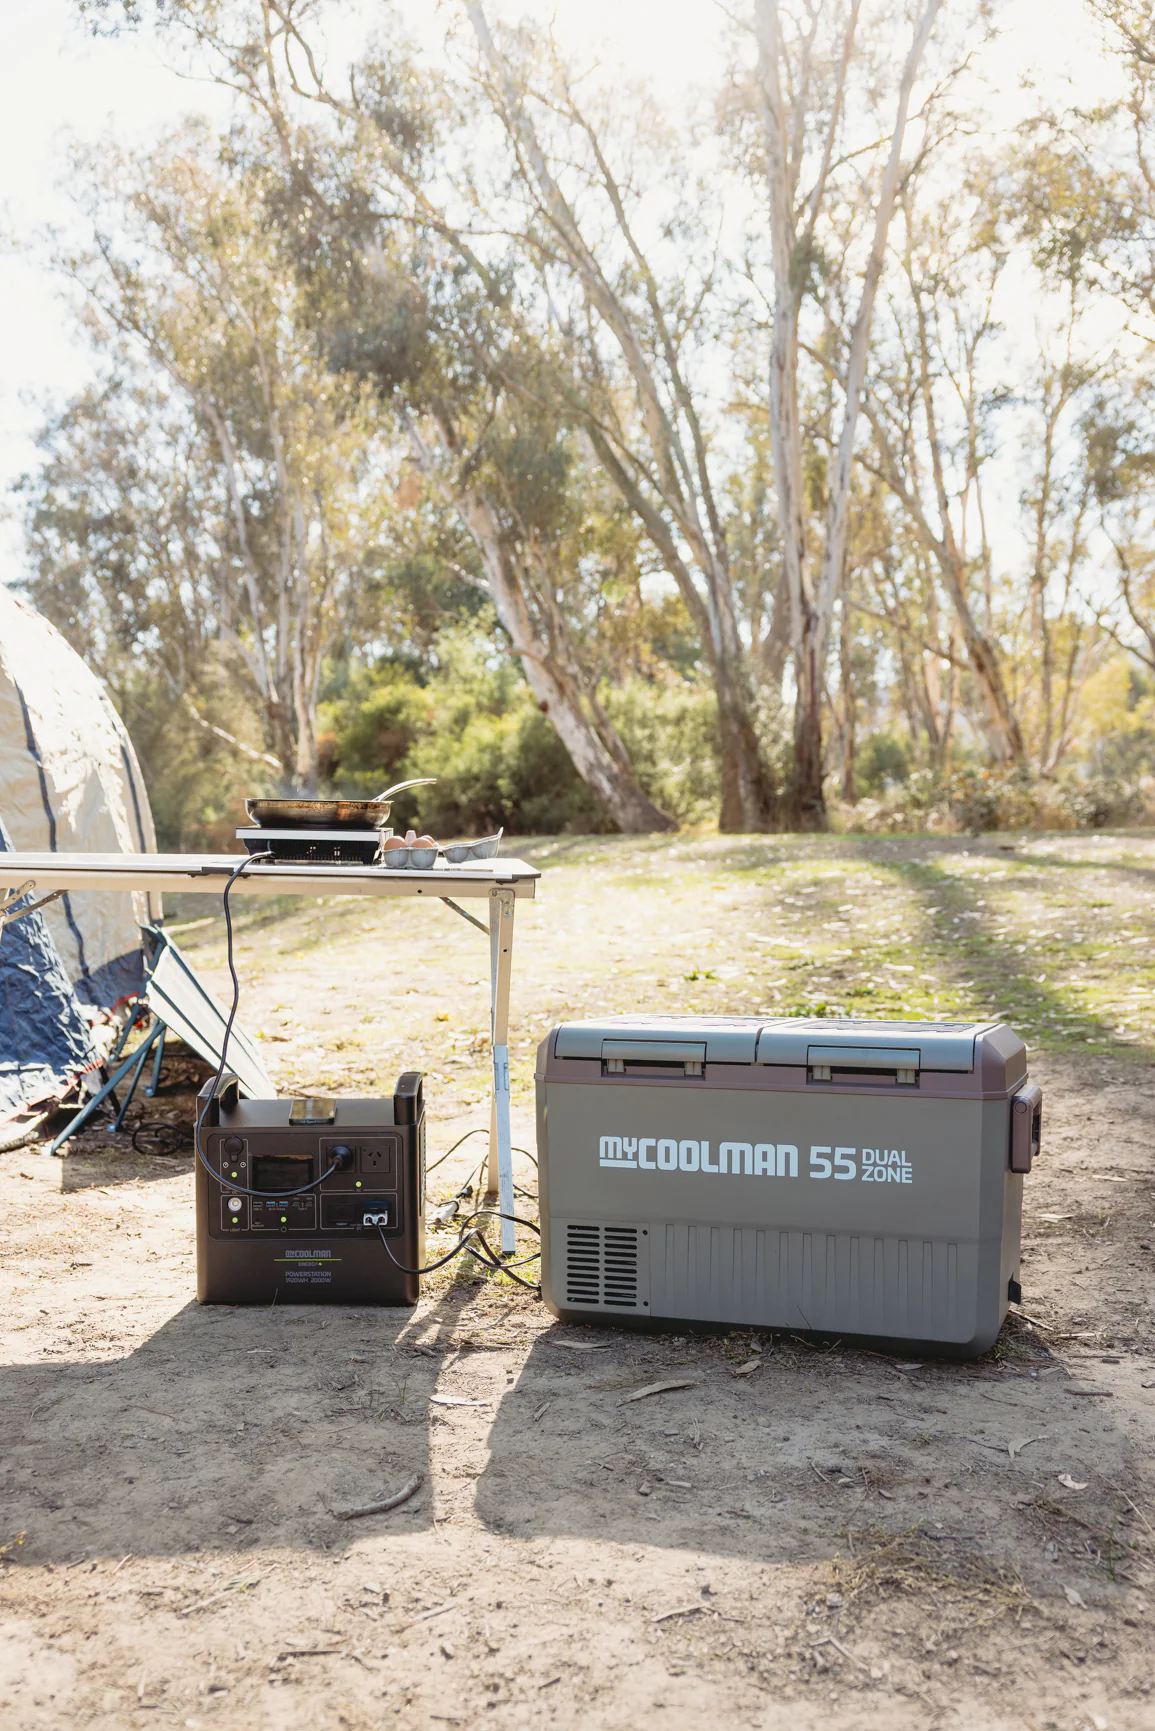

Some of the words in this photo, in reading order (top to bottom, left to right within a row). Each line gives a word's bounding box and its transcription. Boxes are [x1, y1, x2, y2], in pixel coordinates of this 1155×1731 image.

[599, 1135, 798, 1177] MYCOOLMAN
[810, 1145, 857, 1180] 55
[862, 1148, 912, 1167] DUAL
[861, 1165, 913, 1184] ZONE
